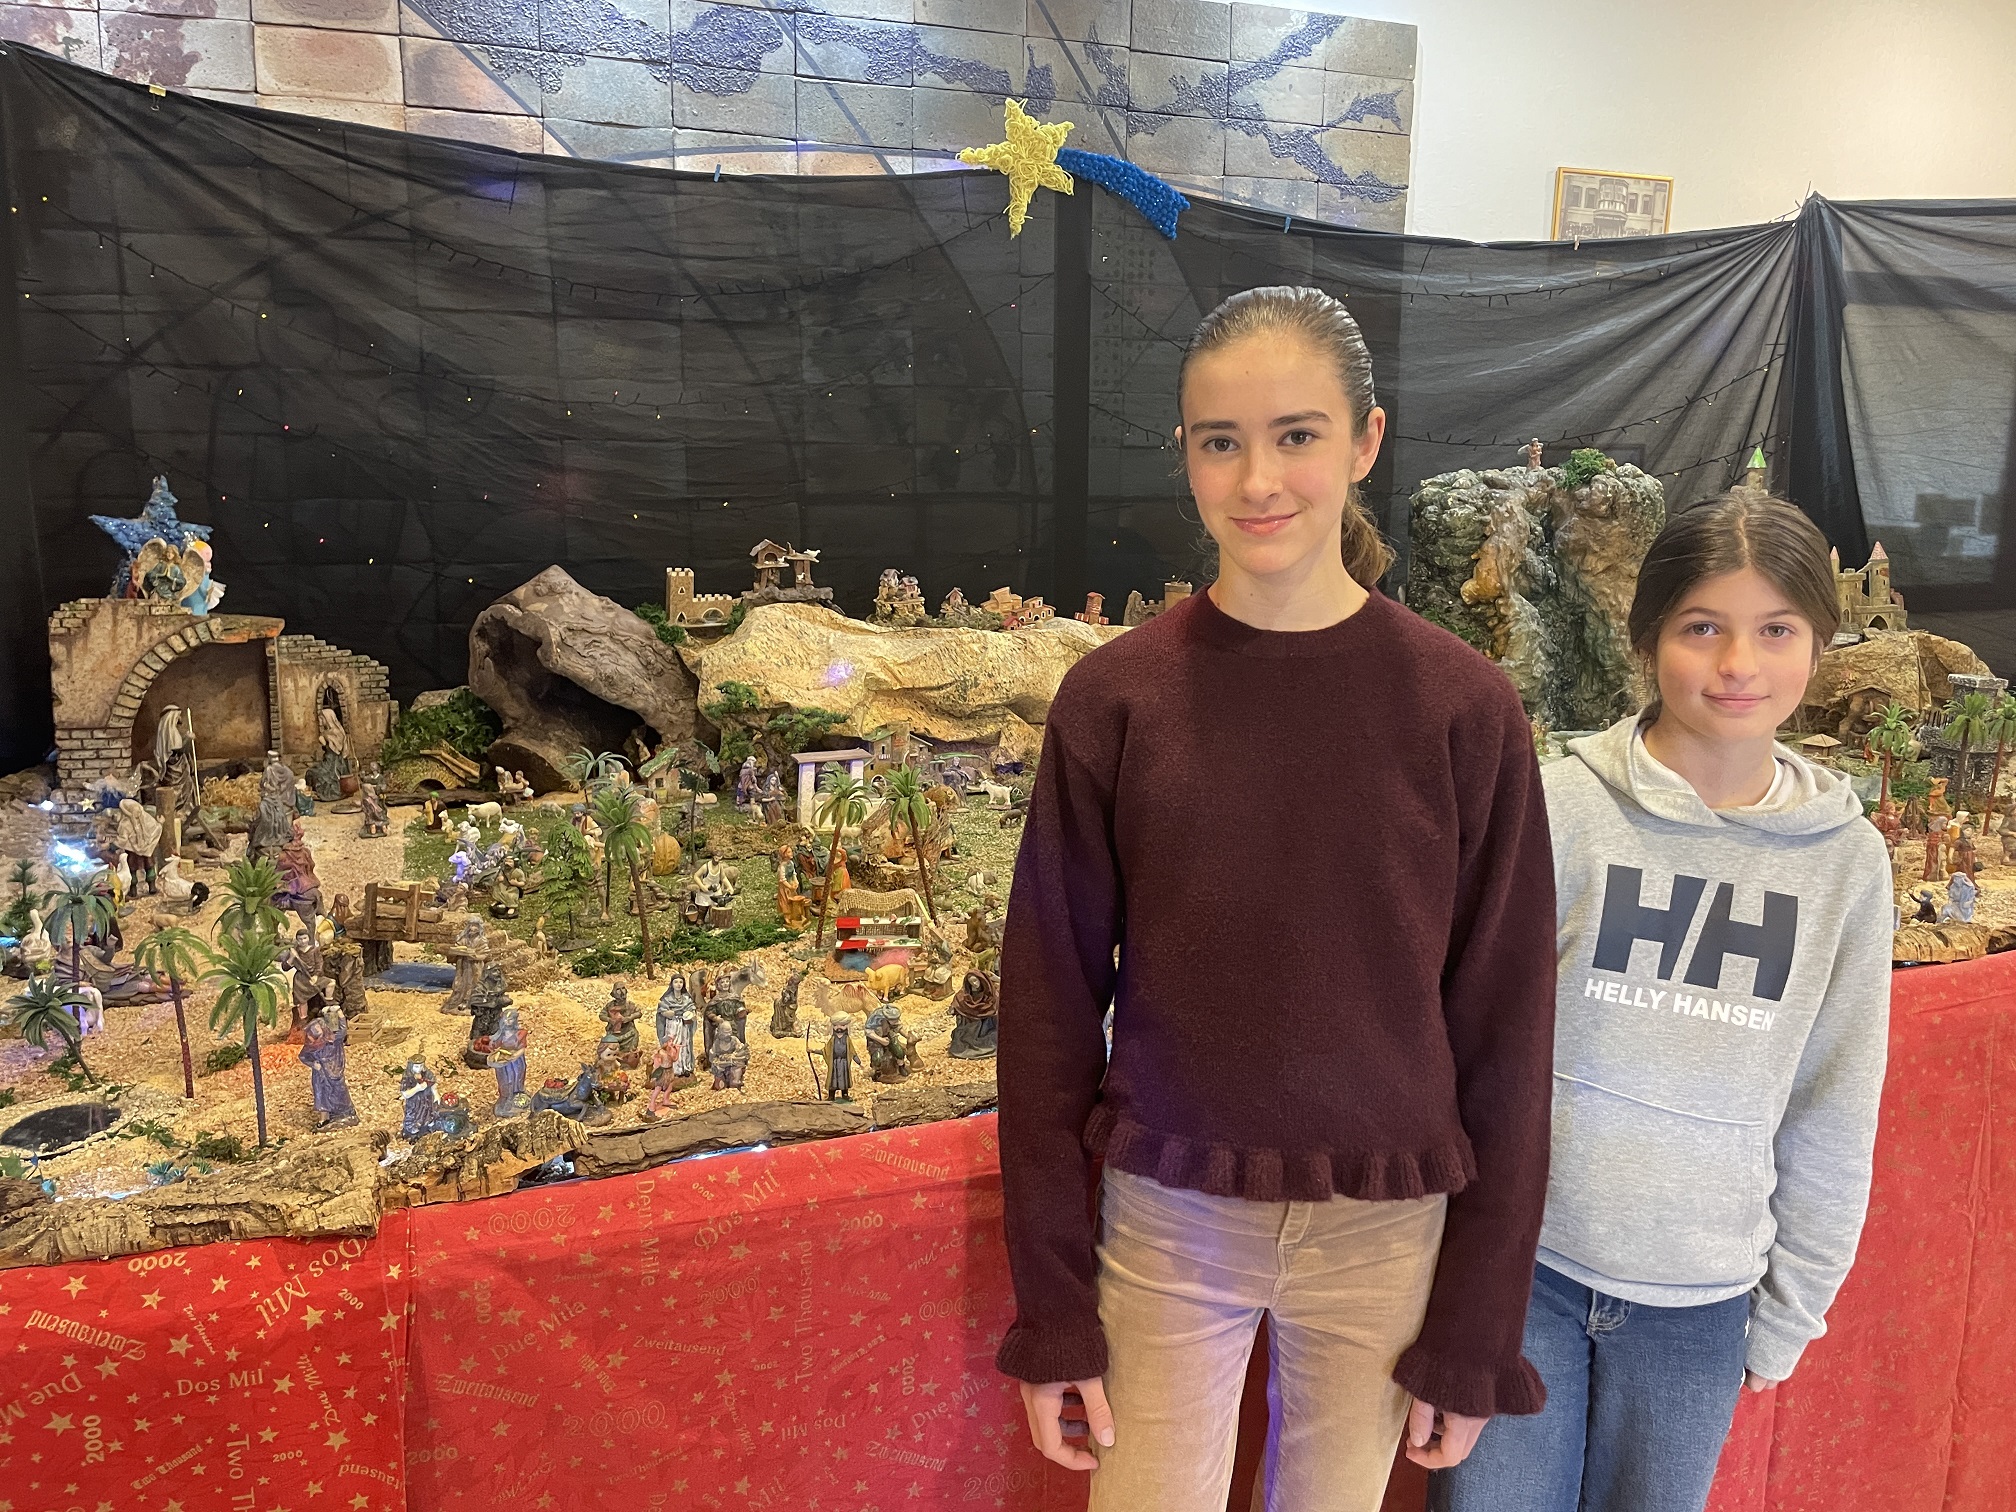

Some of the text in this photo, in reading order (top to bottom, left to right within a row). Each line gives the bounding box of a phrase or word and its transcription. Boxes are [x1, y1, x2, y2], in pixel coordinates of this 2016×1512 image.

[1584, 978, 1776, 1032] HELLY HANSEN
[859, 1143, 951, 1182] Zweitausend
[691, 1182, 715, 1201] 2000
[694, 1168, 781, 1251] Dos Mil
[488, 1203, 576, 1237] 2000
[636, 1179, 660, 1287] Deux Mille
[839, 1213, 884, 1234] 2000
[128, 1251, 188, 1273] 2000
[308, 1237, 367, 1278] Dos
[255, 1274, 310, 1327] Mil
[337, 1288, 364, 1311] 2000
[473, 1279, 493, 1325] 2000
[698, 1276, 760, 1308] 2000
[919, 1291, 989, 1321] 2000
[489, 1301, 587, 1361] Due Mila
[794, 1240, 813, 1384] Two Thousand
[24, 1309, 147, 1361] Zweitausend
[633, 1334, 727, 1356] Zweitausend
[27, 1371, 85, 1405] Due
[176, 1368, 264, 1398] Dos Mil
[296, 1353, 342, 1427] Deux Mille
[432, 1373, 540, 1408] Zweitausend
[901, 1355, 916, 1397] 2000
[562, 1400, 666, 1439] 2000
[909, 1377, 991, 1430] Due Mila
[82, 1414, 105, 1463] 2000
[781, 1414, 846, 1441] Dos Mil
[225, 1432, 250, 1480] Two
[272, 1450, 303, 1463] 2000
[406, 1448, 458, 1466] 2000
[337, 1463, 402, 1491] tausend
